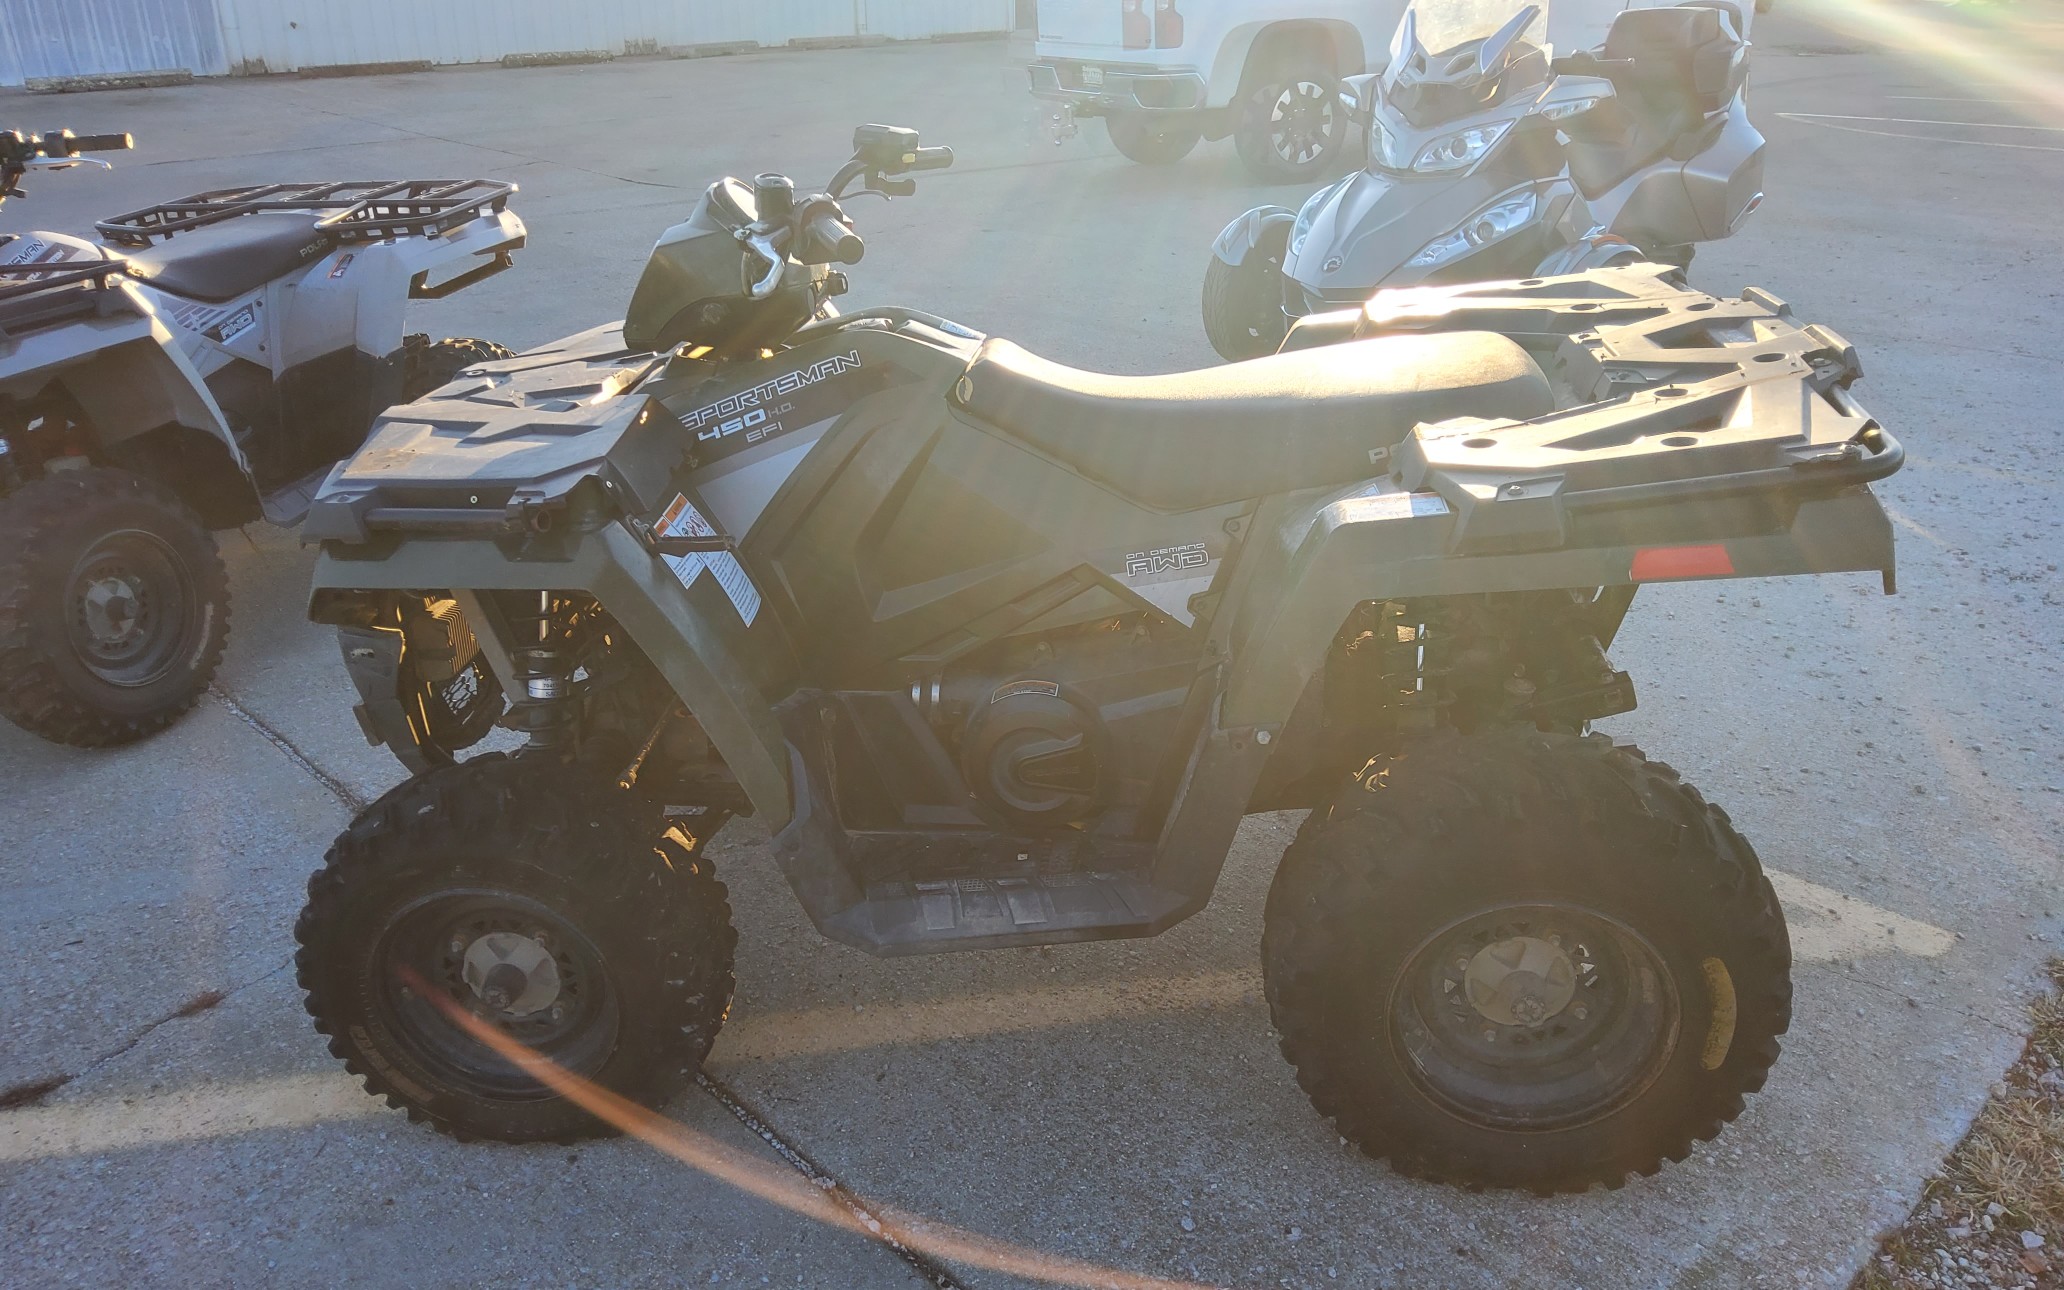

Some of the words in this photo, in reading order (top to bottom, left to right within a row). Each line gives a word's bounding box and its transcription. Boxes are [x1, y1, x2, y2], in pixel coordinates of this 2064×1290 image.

[220, 313, 253, 339] AWD
[678, 350, 862, 431] SPORTSMAN
[698, 408, 767, 441] 450
[767, 402, 796, 418] H.O.
[746, 421, 783, 443] EFI
[1150, 543, 1205, 556] DEMAND
[1127, 550, 1209, 577] AWD
